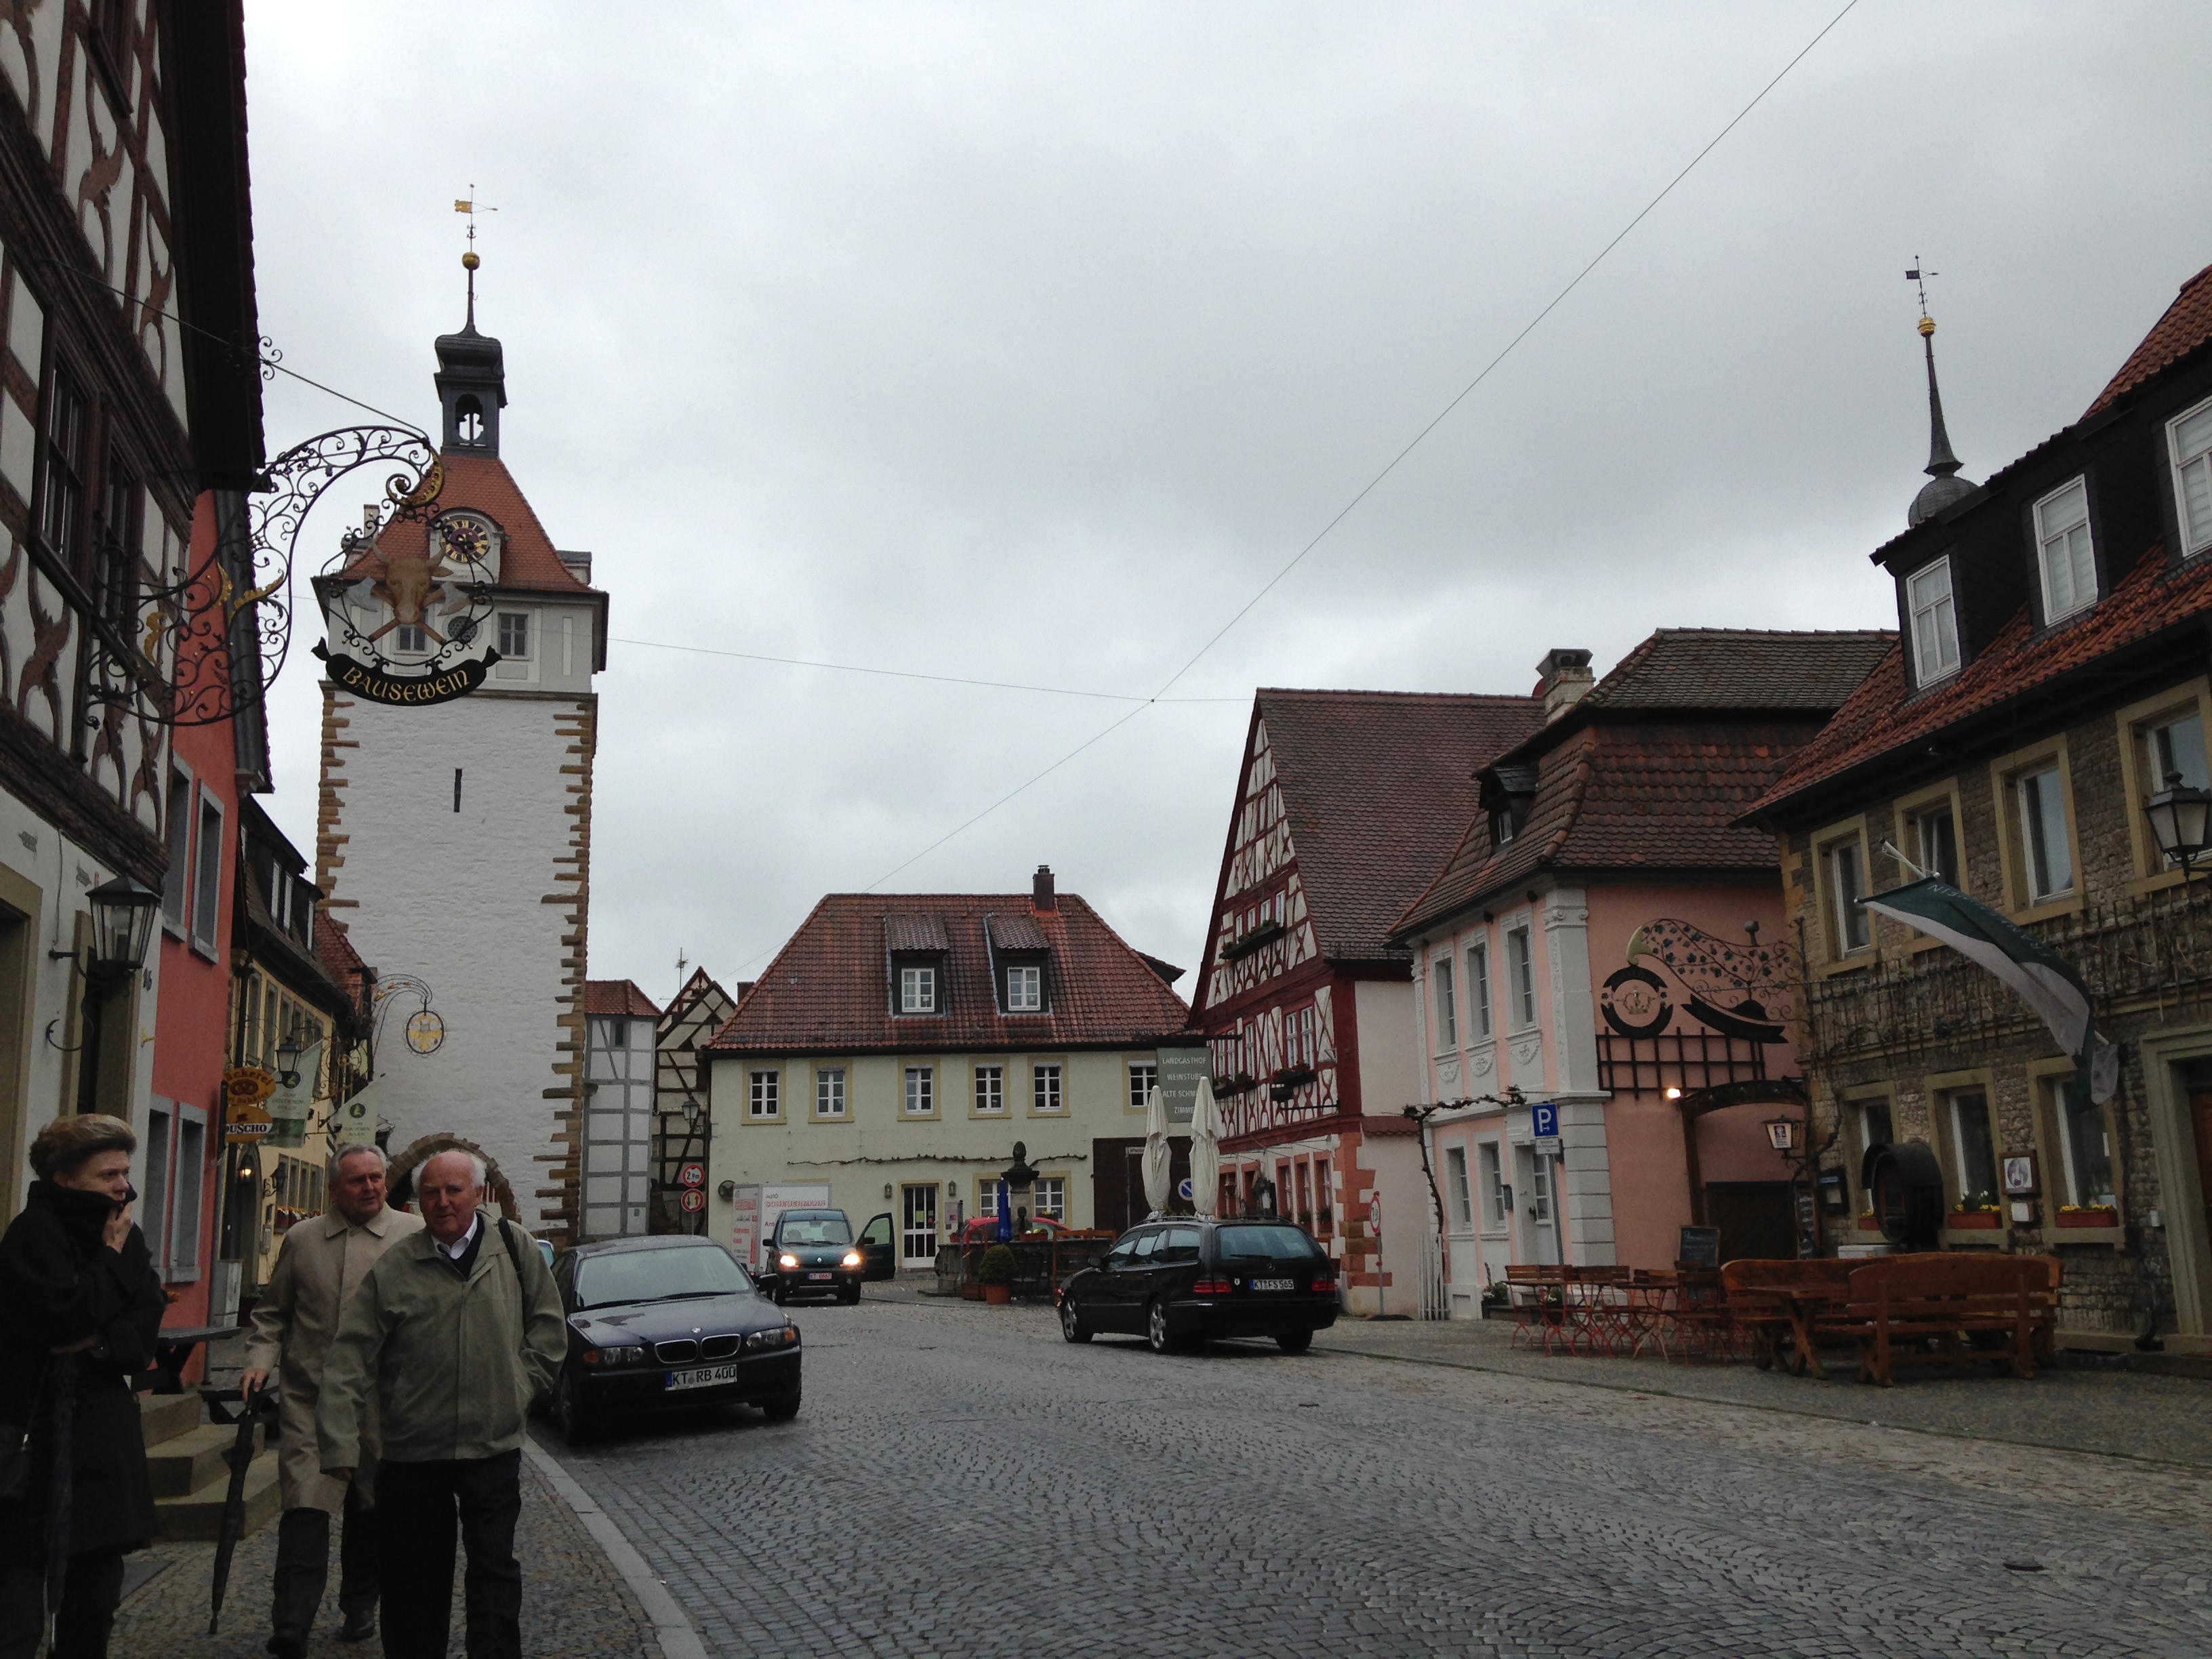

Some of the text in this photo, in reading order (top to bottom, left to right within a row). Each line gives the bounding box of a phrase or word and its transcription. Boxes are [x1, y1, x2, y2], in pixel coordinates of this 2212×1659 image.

[342, 667, 470, 701] BAUSEWEIN
[1538, 1108, 1551, 1132] P
[672, 1366, 736, 1385] KT RB 400
